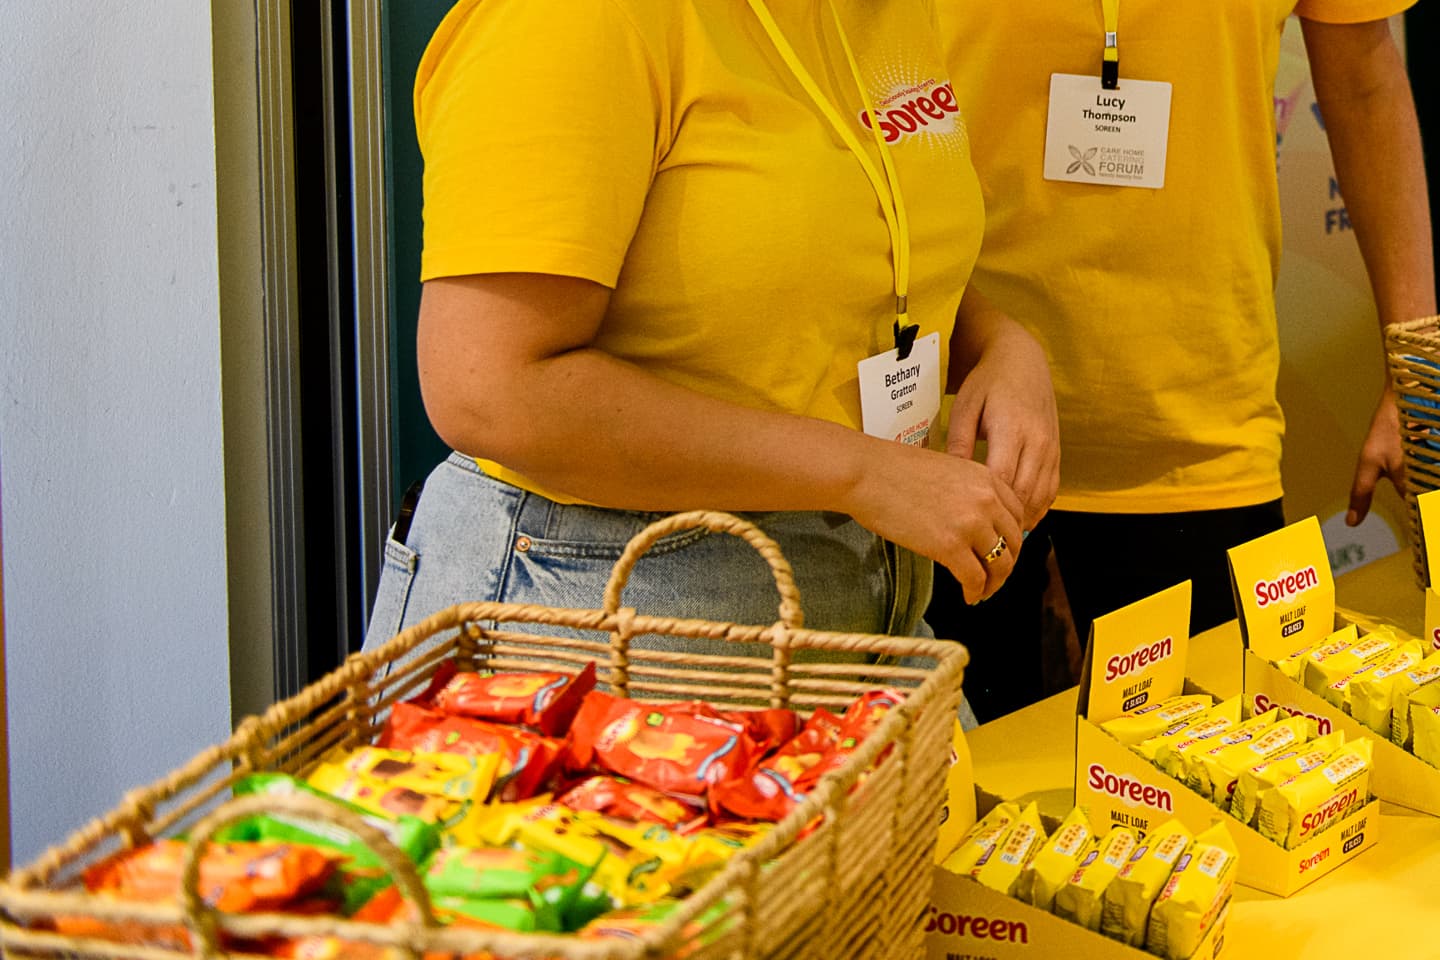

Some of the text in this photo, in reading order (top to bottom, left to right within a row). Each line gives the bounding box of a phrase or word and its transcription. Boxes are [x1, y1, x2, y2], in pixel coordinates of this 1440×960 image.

[861, 83, 959, 143] Soree
[1096, 95, 1126, 111] Lucy
[1082, 109, 1136, 123] Thompson
[1095, 124, 1121, 133] SOREEN
[1100, 154, 1144, 165] CATERING
[1122, 148, 1144, 157] HOME
[1099, 161, 1144, 175] FORUM
[884, 363, 921, 388] Bethany
[890, 382, 917, 401] Gratton
[1255, 567, 1318, 606] Soreen
[1279, 605, 1307, 625] MALT LOAF
[1283, 621, 1303, 636] 2 SLICES
[1105, 637, 1172, 682] Soreen
[1122, 677, 1153, 699] MALT LOAF
[1124, 694, 1147, 710] 2 SLICES
[1088, 764, 1172, 812] Soreen
[1111, 809, 1149, 830] MALT LOAF
[1299, 788, 1358, 837] Soreen
[1340, 816, 1368, 842] MALT LOAF
[1298, 847, 1330, 874] Soreen
